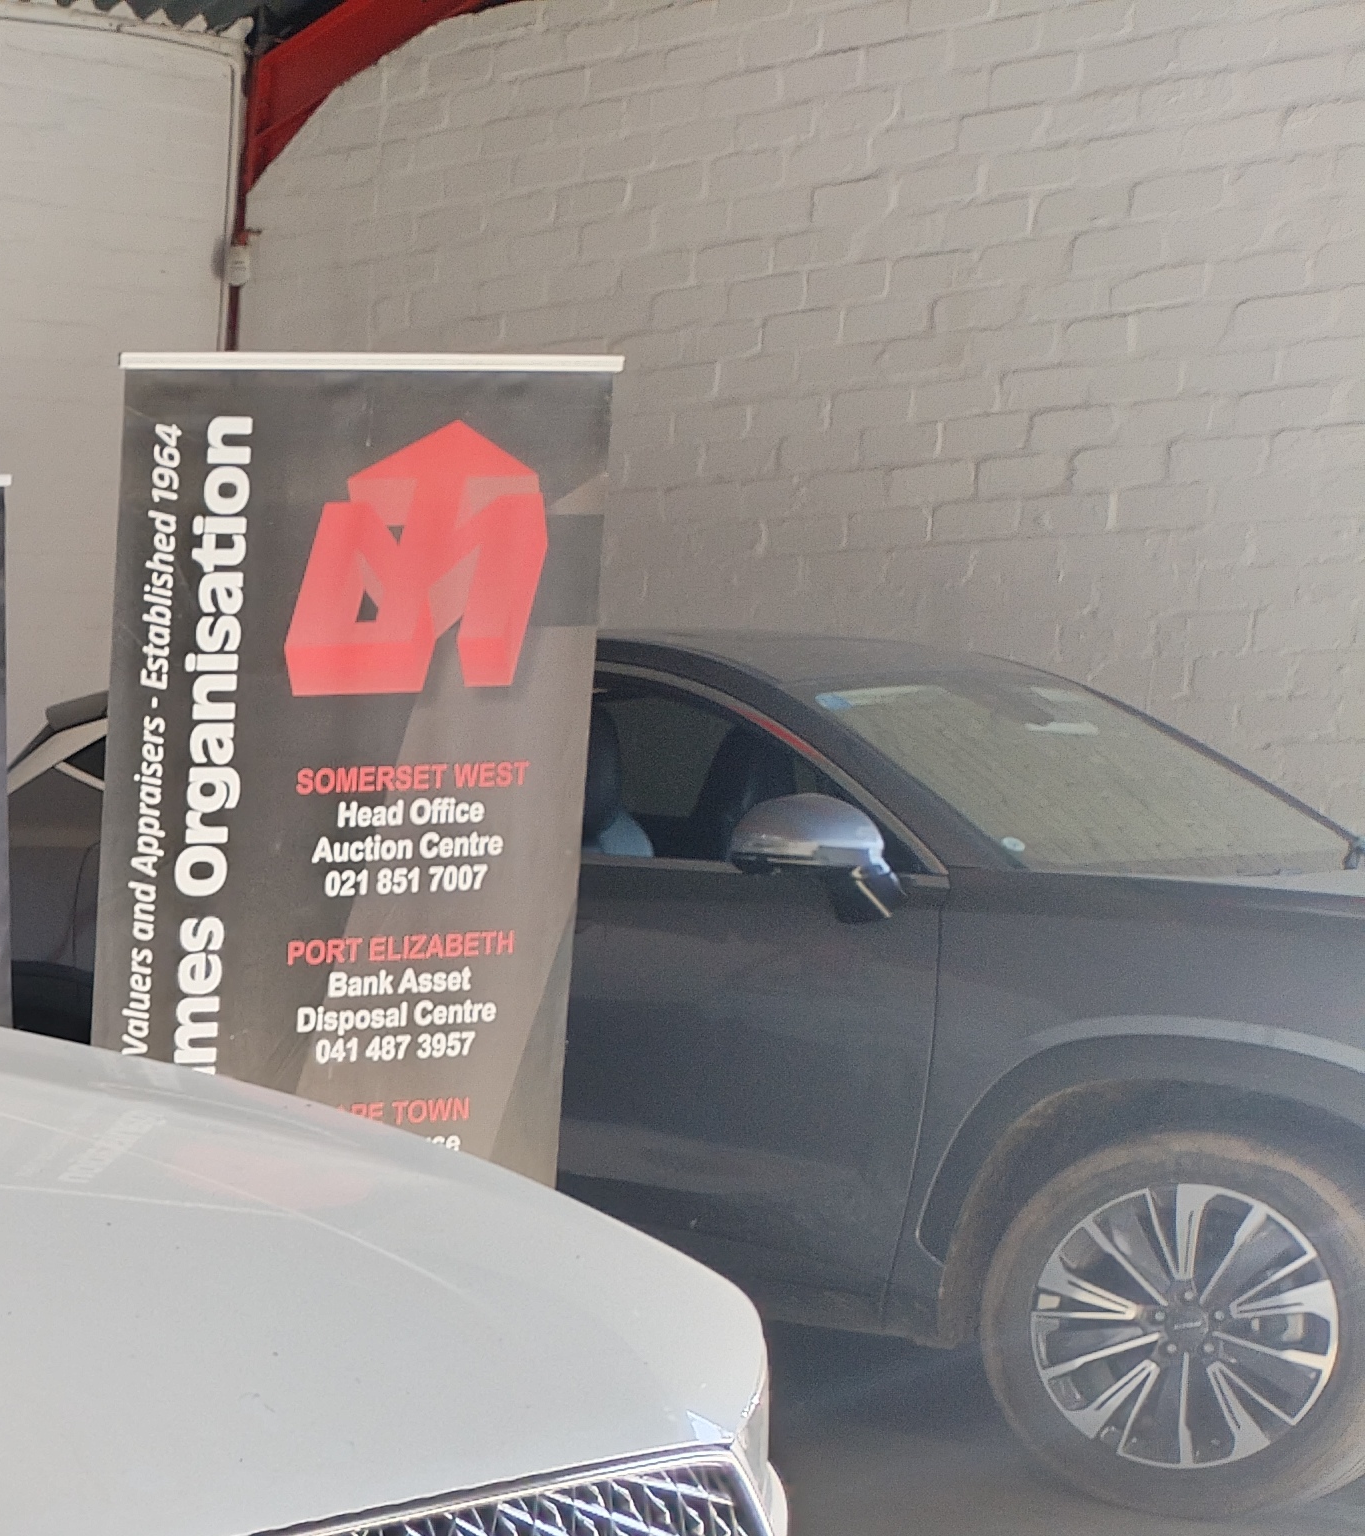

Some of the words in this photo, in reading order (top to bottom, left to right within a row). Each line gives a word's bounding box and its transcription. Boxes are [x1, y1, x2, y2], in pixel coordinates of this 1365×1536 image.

[151, 423, 183, 501] 1964
[140, 509, 179, 690] Established
[173, 415, 254, 898] Organisation
[296, 764, 447, 796] SOMERSET
[454, 761, 530, 788] WEST
[131, 716, 166, 877] Appraisers
[337, 801, 403, 828] Head
[409, 798, 485, 825] Office
[311, 835, 413, 864] Auction
[420, 831, 503, 859] Centre
[324, 871, 368, 897] 021
[376, 868, 420, 894] 851
[429, 865, 488, 892] 7007
[128, 881, 158, 940] and
[287, 937, 362, 966] PORT
[369, 931, 514, 963] ELIZABETH
[174, 915, 225, 1076] mes
[328, 970, 394, 998] Bank
[398, 966, 471, 993] Asset
[122, 947, 153, 1056] Valuers
[296, 1003, 407, 1034] Disposal
[414, 1000, 497, 1027] Centre
[315, 1038, 361, 1065] 041
[366, 1035, 410, 1061] 487
[416, 1031, 475, 1059] 3957
[392, 1097, 470, 1126] TOWN
